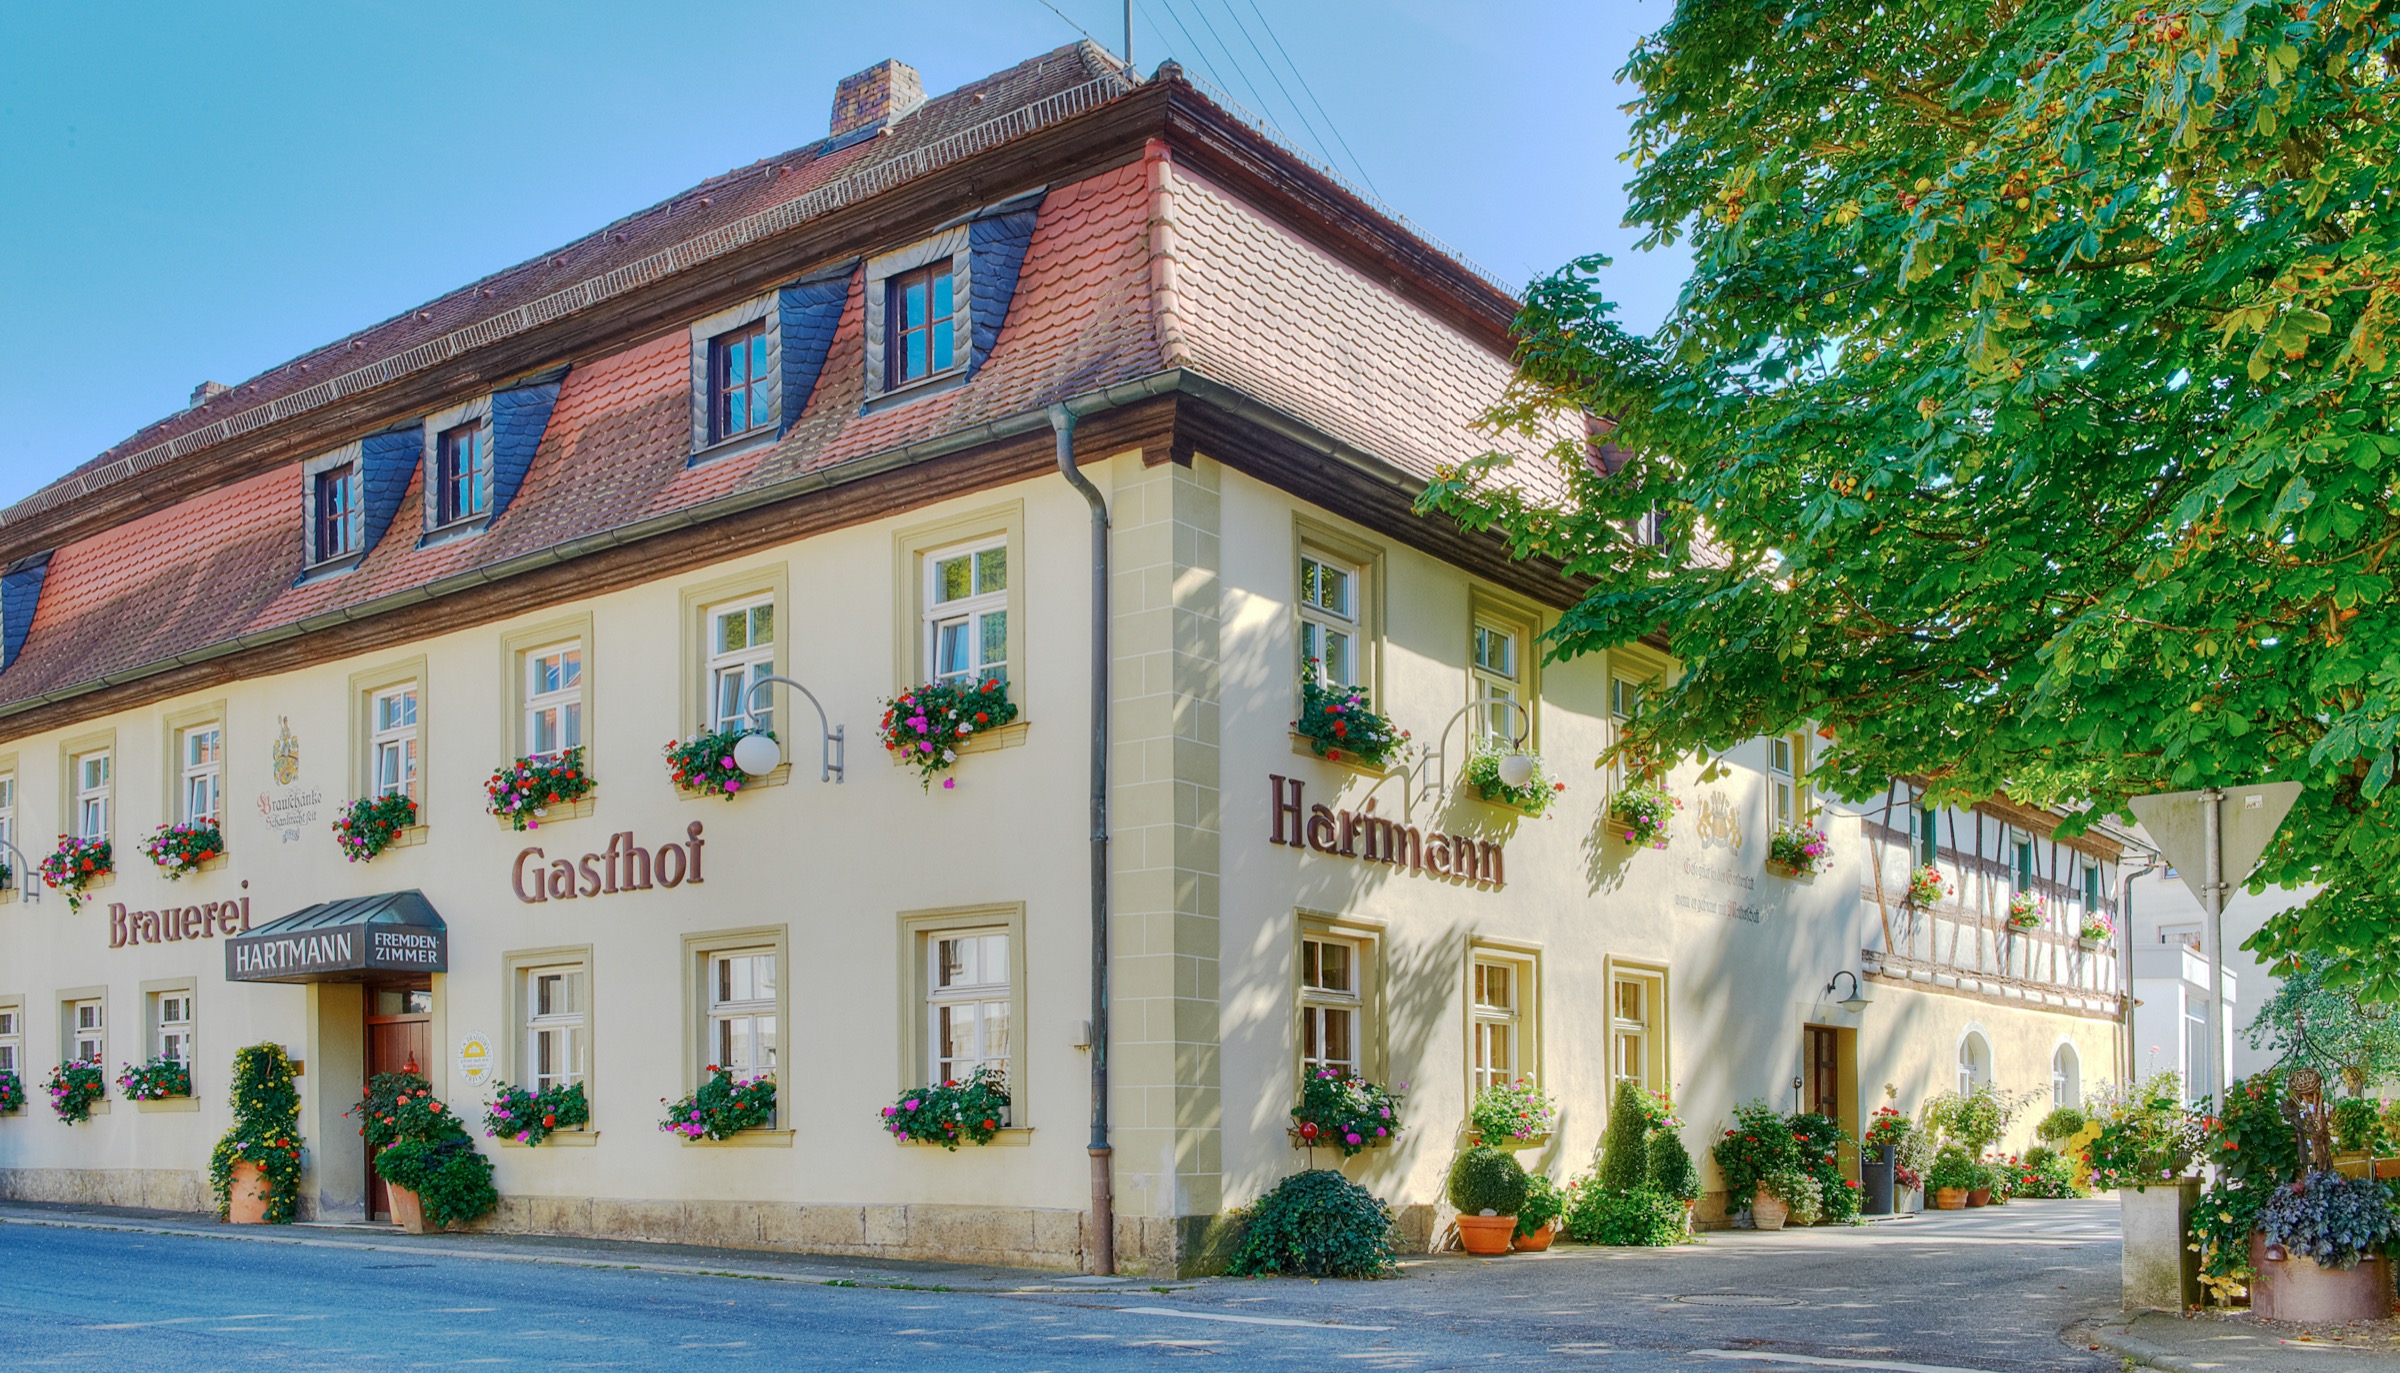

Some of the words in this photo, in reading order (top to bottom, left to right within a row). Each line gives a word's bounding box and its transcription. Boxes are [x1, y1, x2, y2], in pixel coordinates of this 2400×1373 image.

[1269, 774, 1507, 886] Hartmann
[512, 821, 704, 904] Gasthof
[108, 879, 251, 949] Brauerei
[374, 932, 440, 949] FREMDEN-
[236, 932, 352, 972] HARTMANN
[375, 947, 438, 963] ZIMMER
